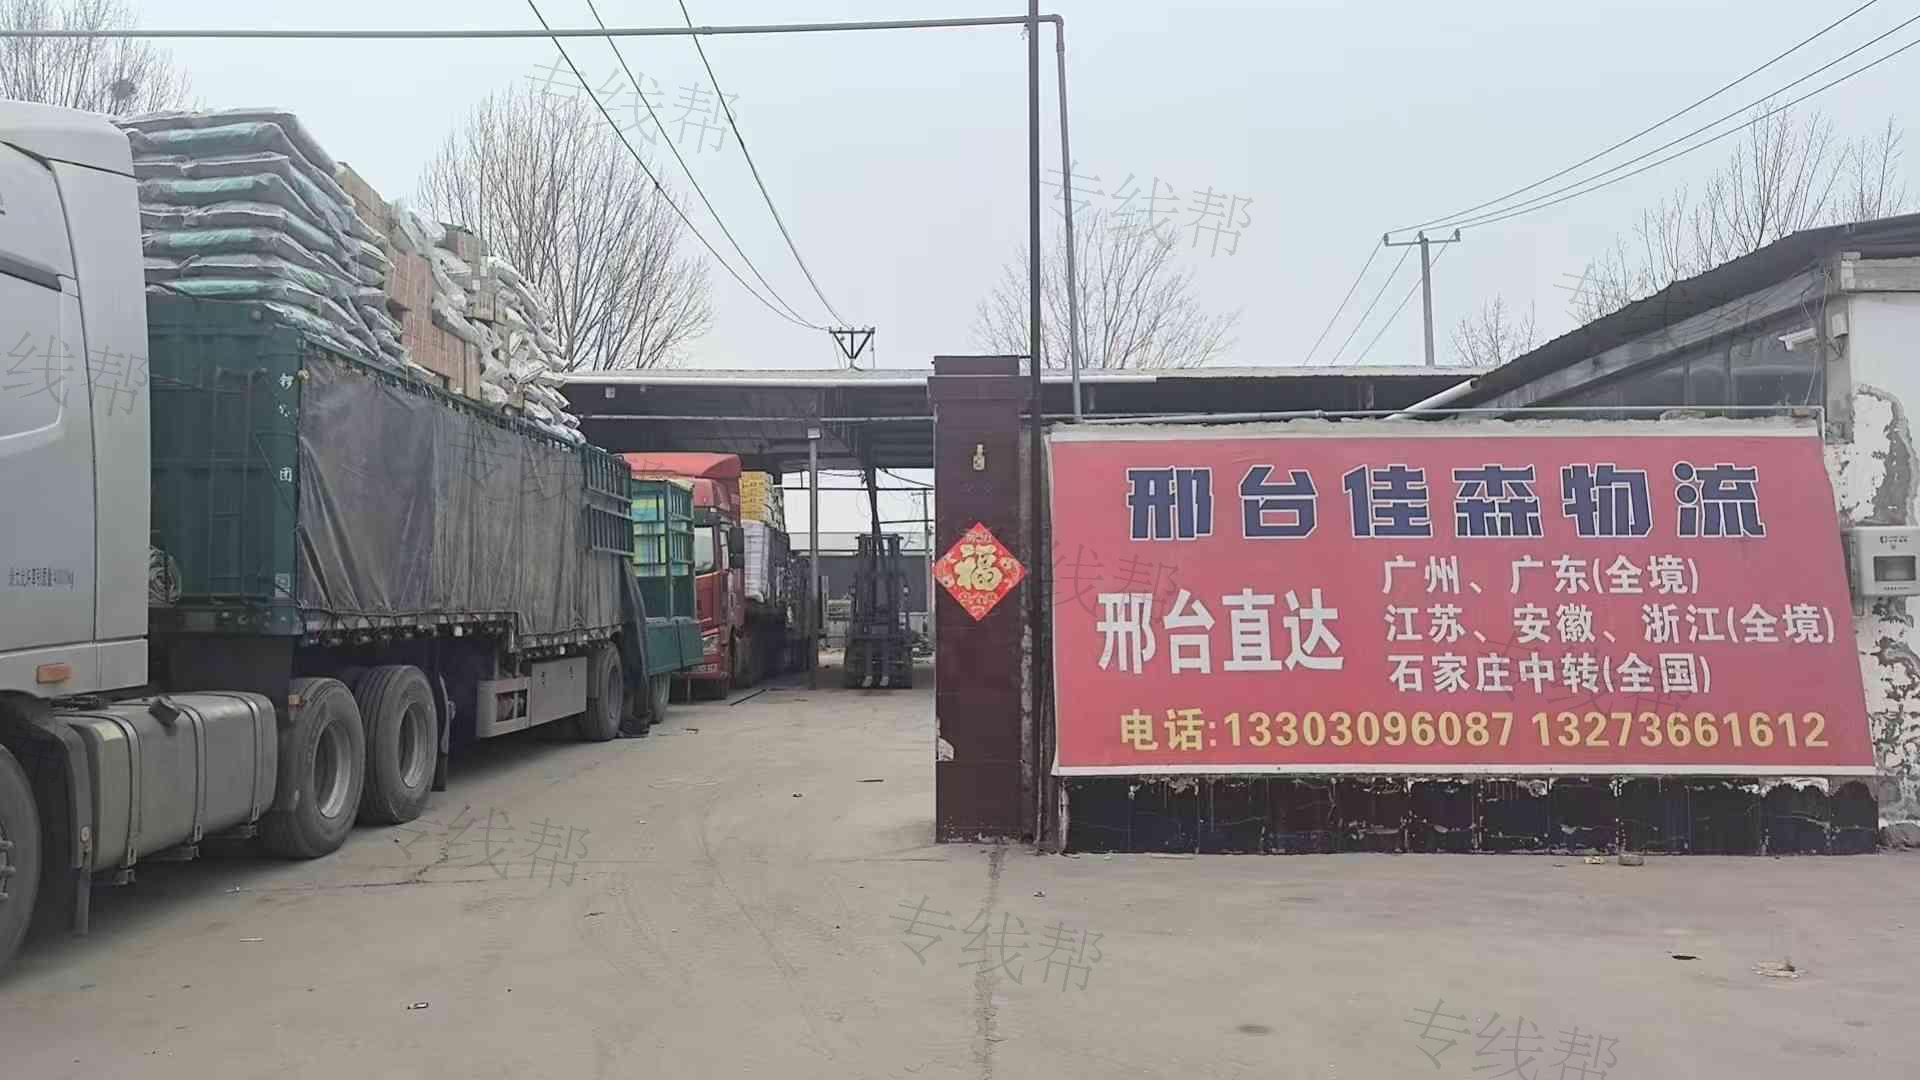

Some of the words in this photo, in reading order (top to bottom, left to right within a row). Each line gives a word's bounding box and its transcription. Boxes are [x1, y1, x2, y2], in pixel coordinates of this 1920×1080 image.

[1126, 461, 1766, 541] 邢台佳森物流
[953, 543, 1003, 592] 福
[1382, 555, 1699, 594] 广州、广东(全境)
[1096, 588, 1344, 675] 邢台直达
[1384, 603, 1835, 644] 江苏、安徽、浙江(全境)
[1389, 651, 1711, 694] 石家庄中转(全国)
[1531, 711, 1829, 747] 13273661612
